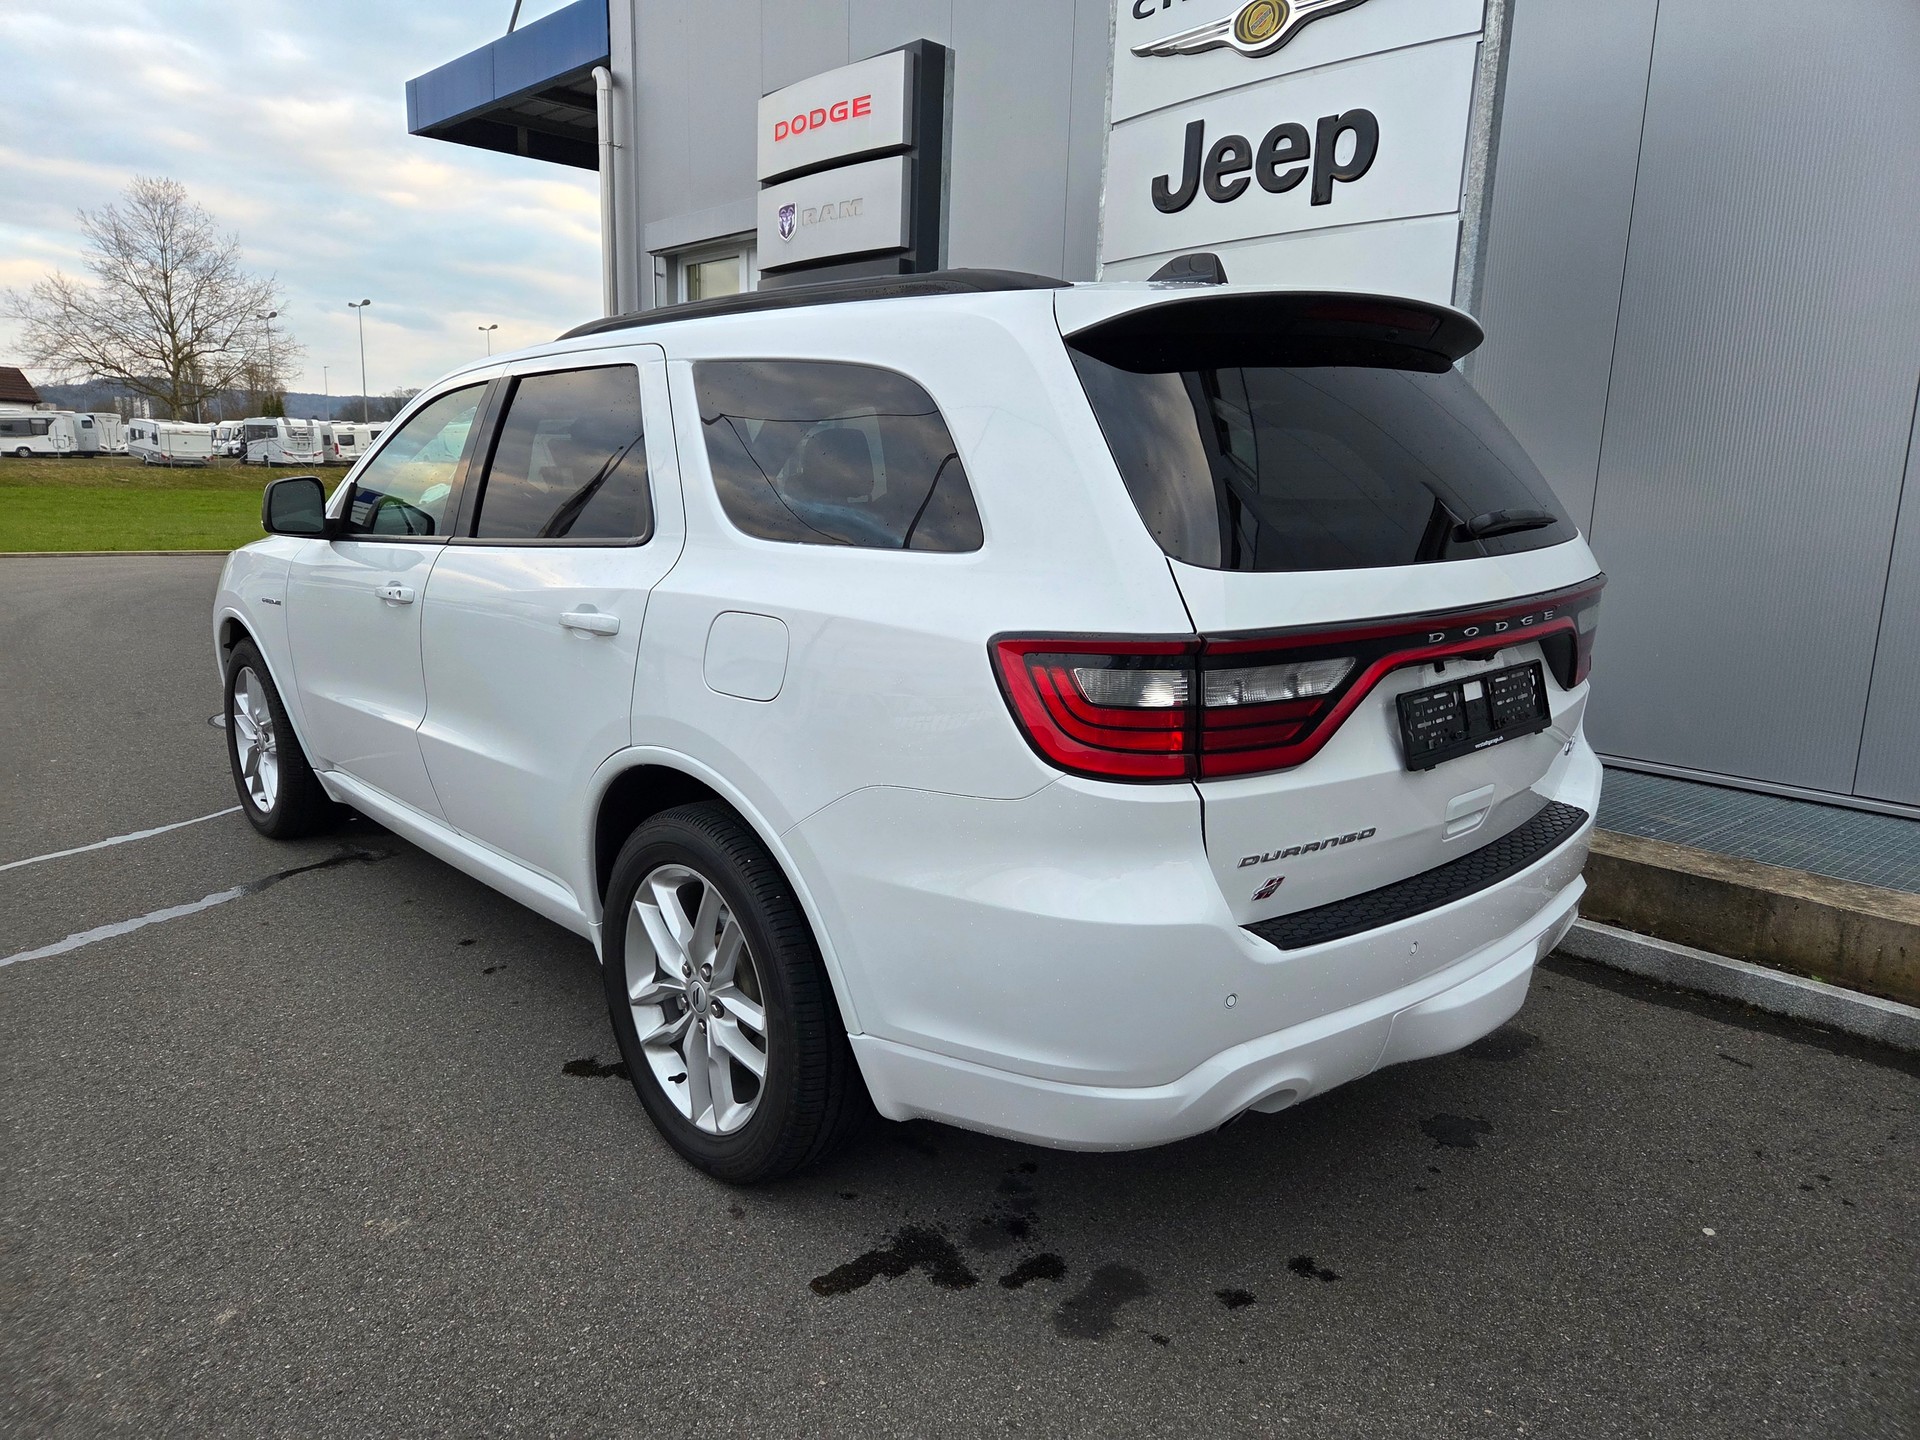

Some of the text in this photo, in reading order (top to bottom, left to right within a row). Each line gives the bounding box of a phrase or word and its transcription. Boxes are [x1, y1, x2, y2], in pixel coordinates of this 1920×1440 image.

[774, 94, 872, 142] DODGE
[1151, 107, 1380, 214] Jeep
[801, 197, 864, 227] RAM
[1428, 610, 1554, 644] DODGE
[1237, 827, 1377, 869] DURANGO
